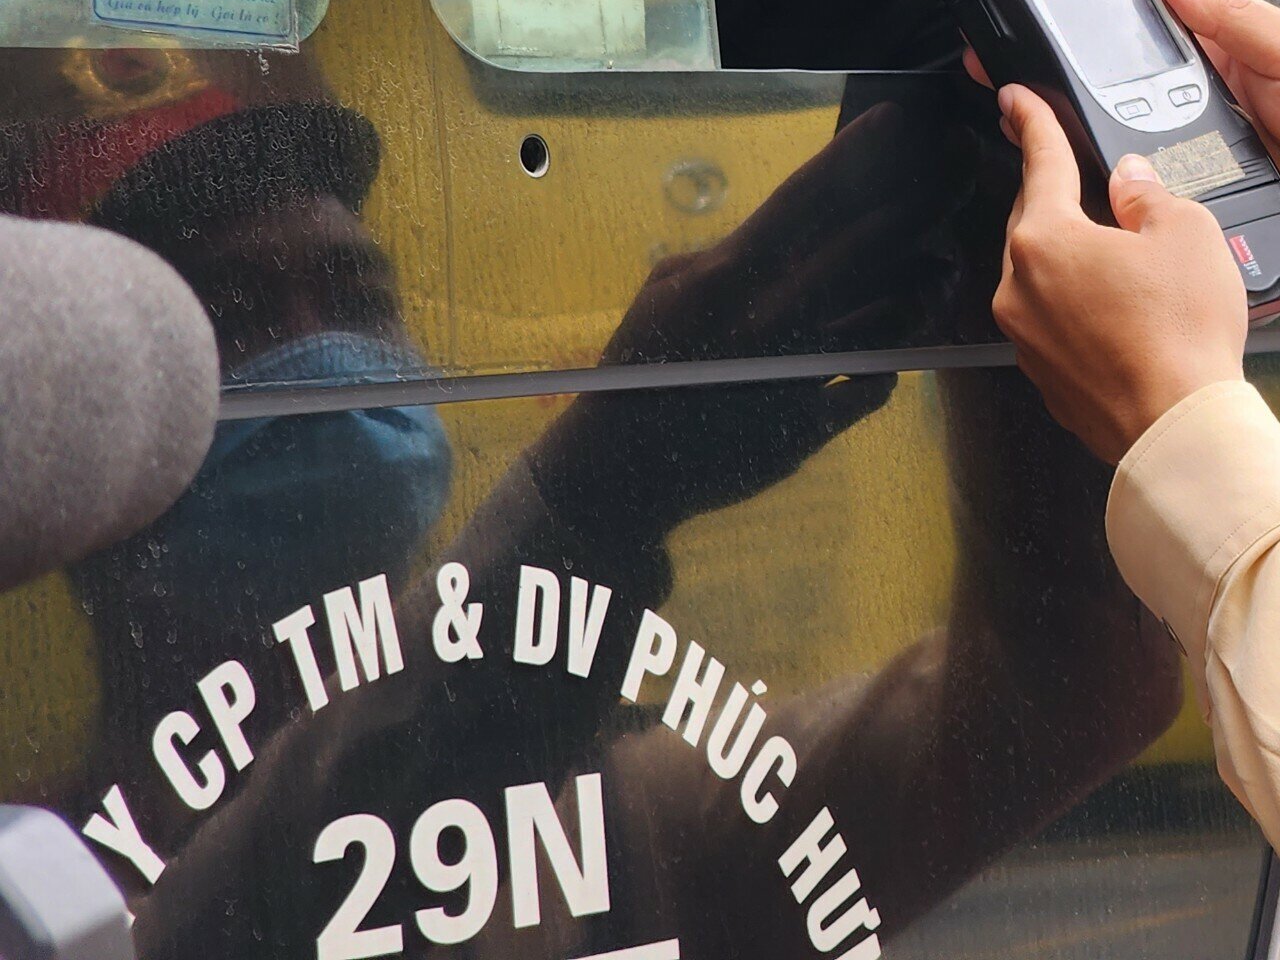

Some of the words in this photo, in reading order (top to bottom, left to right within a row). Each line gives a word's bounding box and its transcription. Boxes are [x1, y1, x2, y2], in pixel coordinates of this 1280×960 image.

[153, 661, 255, 809] CP
[273, 574, 404, 711] TM
[433, 562, 483, 662] &
[514, 565, 612, 678] DV
[621, 609, 796, 823] PHÚC
[314, 773, 610, 960] 29N
